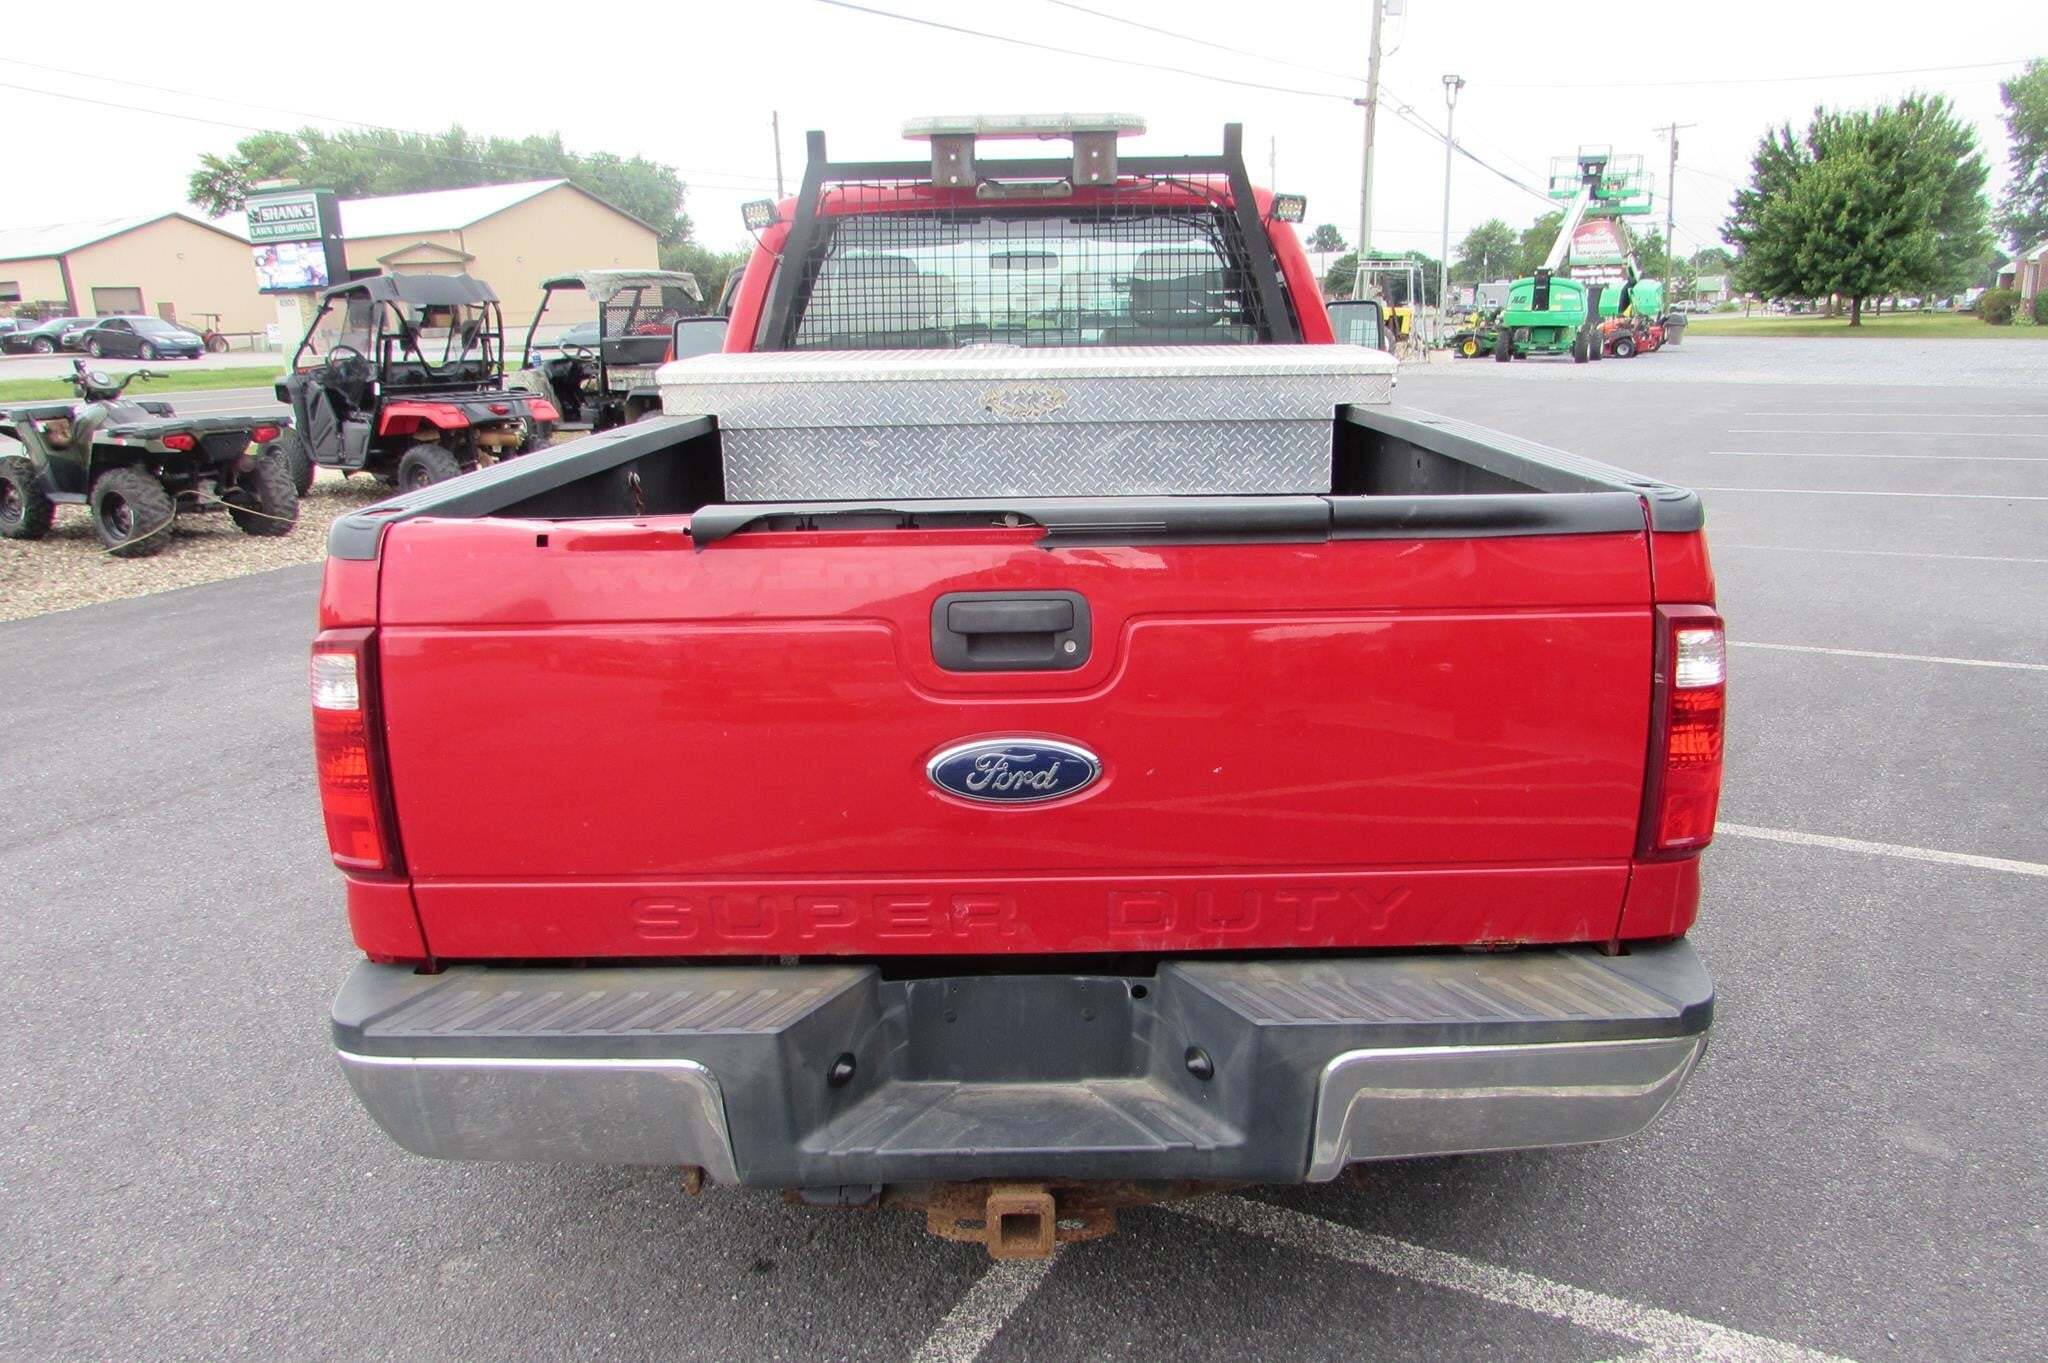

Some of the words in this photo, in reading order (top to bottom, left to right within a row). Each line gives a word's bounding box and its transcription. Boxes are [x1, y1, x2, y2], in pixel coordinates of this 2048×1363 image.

[262, 204, 313, 221] SHANK'S
[251, 226, 273, 236] LAWN
[274, 223, 315, 234] EQUIPMENT
[966, 752, 1061, 791] Ford
[631, 892, 1017, 939] SUPER
[1107, 886, 1411, 935] DUTY
